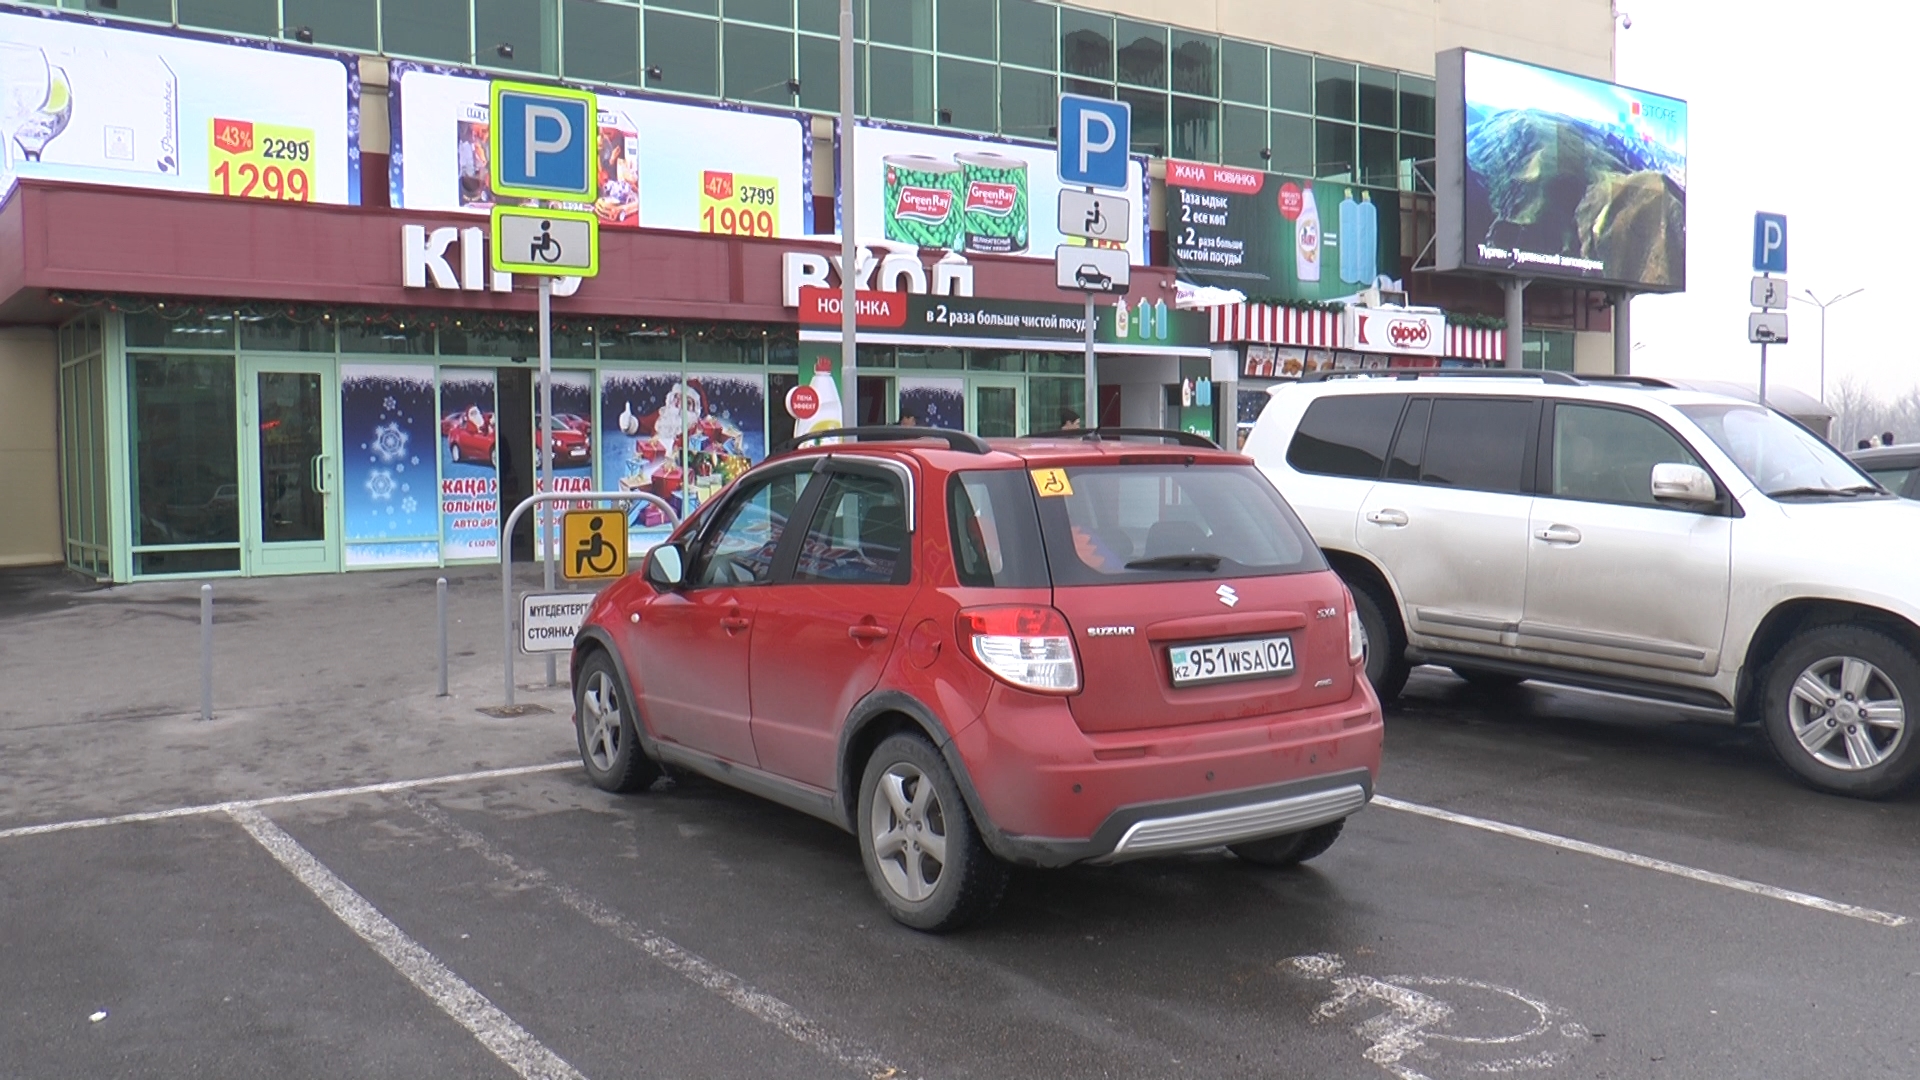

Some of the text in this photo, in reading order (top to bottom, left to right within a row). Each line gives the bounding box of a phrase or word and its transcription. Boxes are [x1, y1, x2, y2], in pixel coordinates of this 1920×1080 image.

[263, 138, 310, 161] 2299
[525, 104, 572, 177] P
[1079, 108, 1116, 173] P
[214, 161, 309, 202] 1299
[1213, 170, 1257, 188] НОВИНКА
[740, 186, 774, 205] 3799
[1180, 189, 1228, 209] Таза ыдыс
[704, 206, 773, 238] 1999
[1181, 205, 1190, 222] 2
[1185, 227, 1195, 245] 2
[1198, 237, 1215, 250] раза
[1216, 236, 1243, 249] больше
[1763, 220, 1782, 264] P
[1177, 248, 1209, 262] чистой
[817, 298, 890, 316] НОНКА
[926, 311, 934, 323] в
[936, 305, 947, 323] 2
[949, 311, 975, 327] раза
[977, 310, 1020, 327] больше
[1021, 314, 1057, 329] чистой
[454, 520, 478, 528] АВТО
[528, 626, 574, 639] СТОЯНКА
[1087, 626, 1135, 637] SUZUKI
[1175, 666, 1190, 679] KZ
